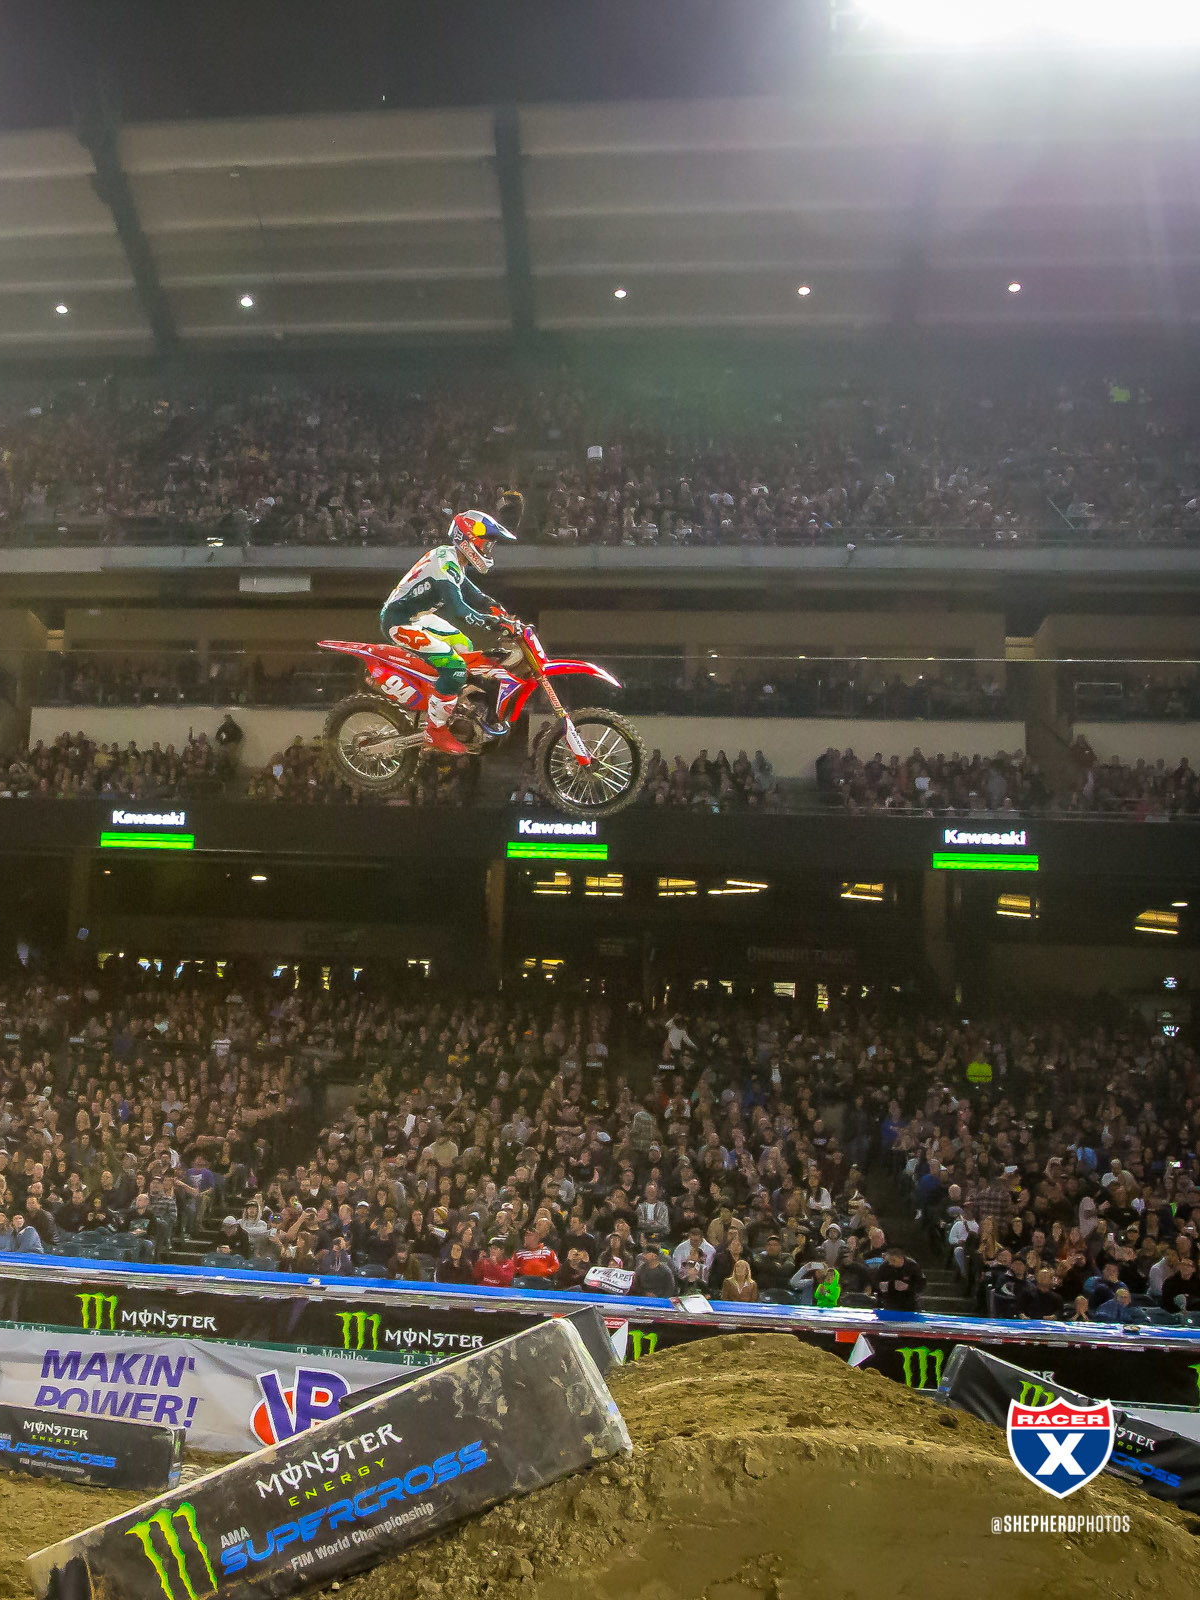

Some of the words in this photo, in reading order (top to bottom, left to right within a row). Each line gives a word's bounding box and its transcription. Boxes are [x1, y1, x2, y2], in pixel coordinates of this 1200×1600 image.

[381, 675, 417, 704] 94
[112, 810, 186, 826] Kawasaki
[519, 819, 597, 836] Kawasaki
[943, 829, 1028, 846] Kawasaki
[121, 1309, 217, 1331] MONSTER
[385, 1328, 484, 1348] MONSTER
[40, 1349, 195, 1388] MAKIN'
[34, 1385, 198, 1428] POWER!
[256, 1366, 351, 1441] VP
[23, 1420, 88, 1440] MONSTER
[31, 1434, 78, 1446] ENERGY
[255, 1423, 403, 1499] MONSTER
[289, 1458, 386, 1507] ENERGY
[220, 1440, 487, 1576] SUPERCROSS
[220, 1526, 250, 1549] AMA
[290, 1551, 309, 1571] FIM
[317, 1538, 351, 1560] World
[351, 1502, 435, 1544] Championship
